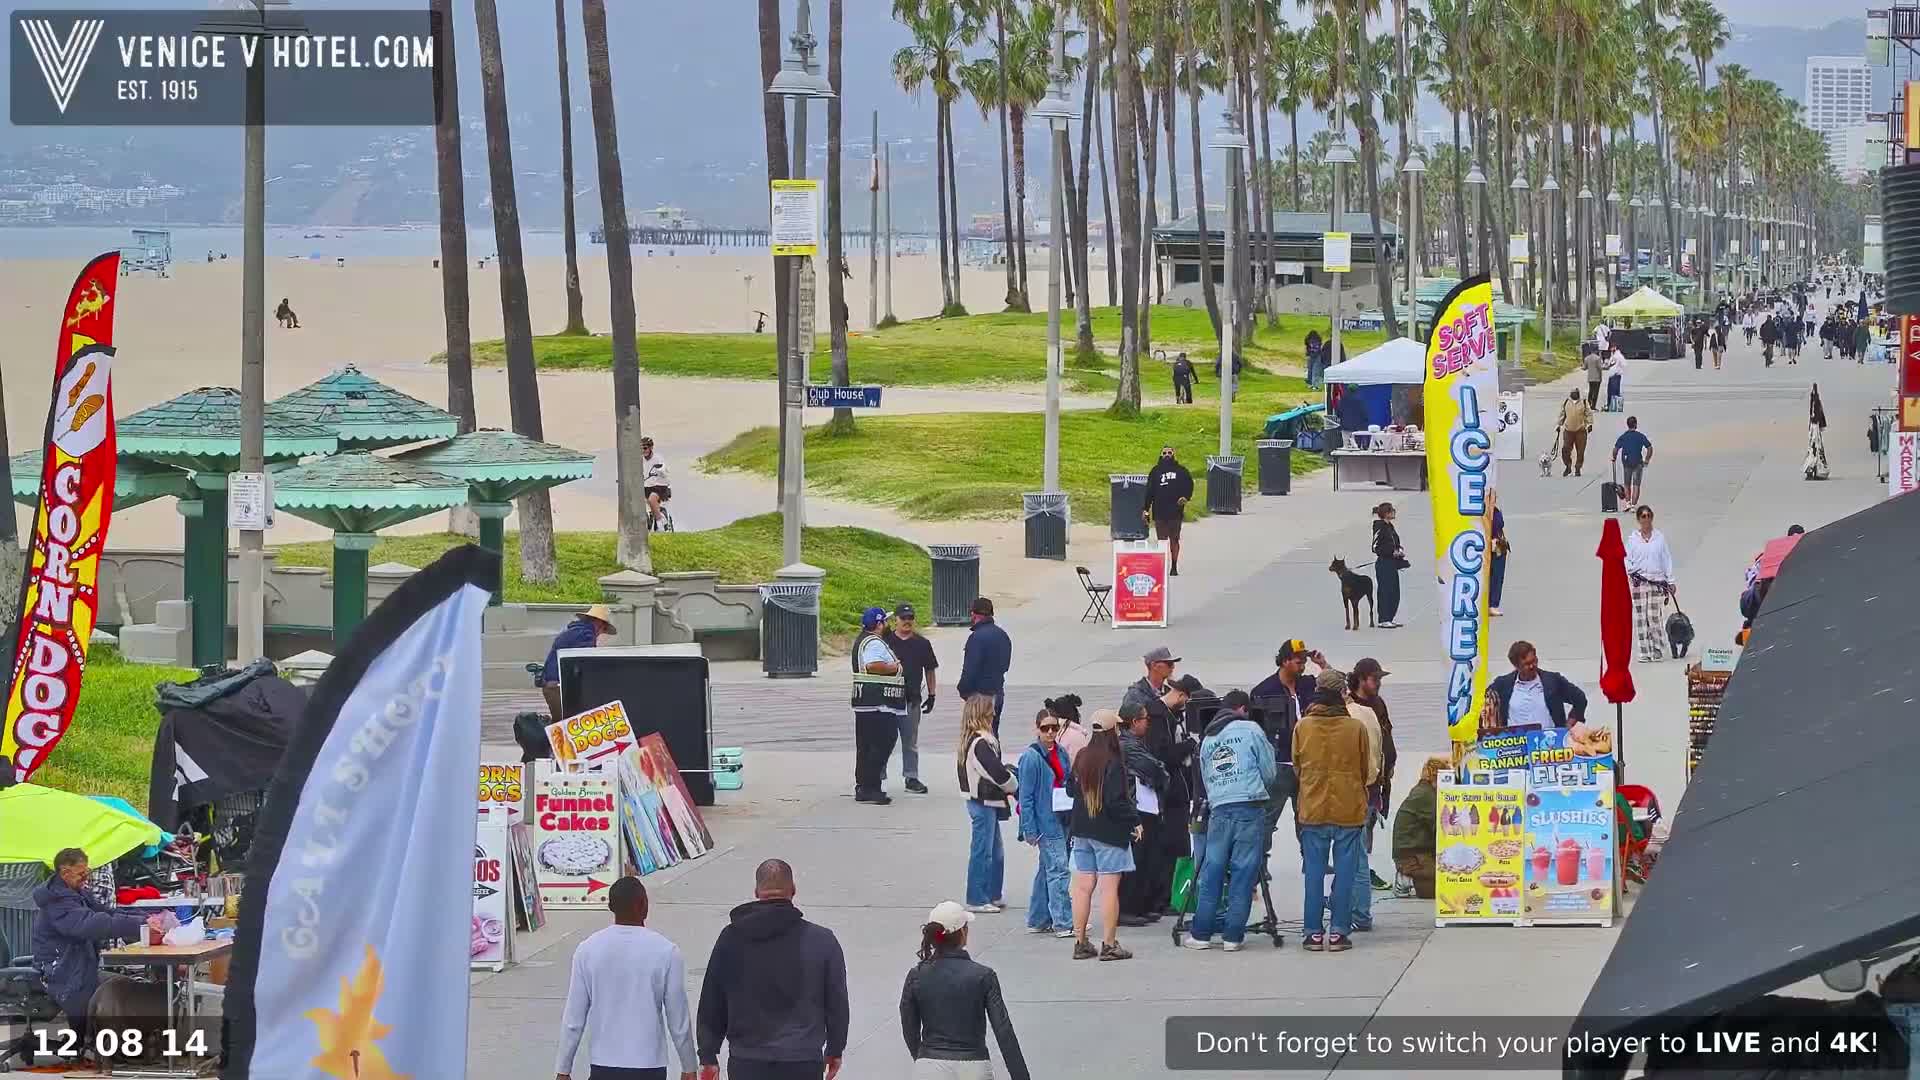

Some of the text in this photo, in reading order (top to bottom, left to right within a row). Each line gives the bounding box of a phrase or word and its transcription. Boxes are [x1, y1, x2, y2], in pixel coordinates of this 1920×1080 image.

[1438, 303, 1490, 351] SOFT
[1432, 327, 1496, 379] SERVE
[809, 388, 864, 400] Club House
[1450, 385, 1491, 516] ICE
[37, 464, 82, 626] CORN
[567, 703, 624, 736] CORN
[572, 720, 631, 753] DOGS
[1482, 735, 1528, 749] CHOCOLAT
[1531, 747, 1574, 764] FRIED
[478, 765, 523, 784] ORN
[1533, 763, 1589, 784] FISH
[477, 784, 523, 802] OGS
[551, 787, 604, 797] Golden Brown
[536, 794, 615, 812] Funnel
[540, 813, 610, 832] Cakes
[1531, 808, 1608, 827] SLUSHIES
